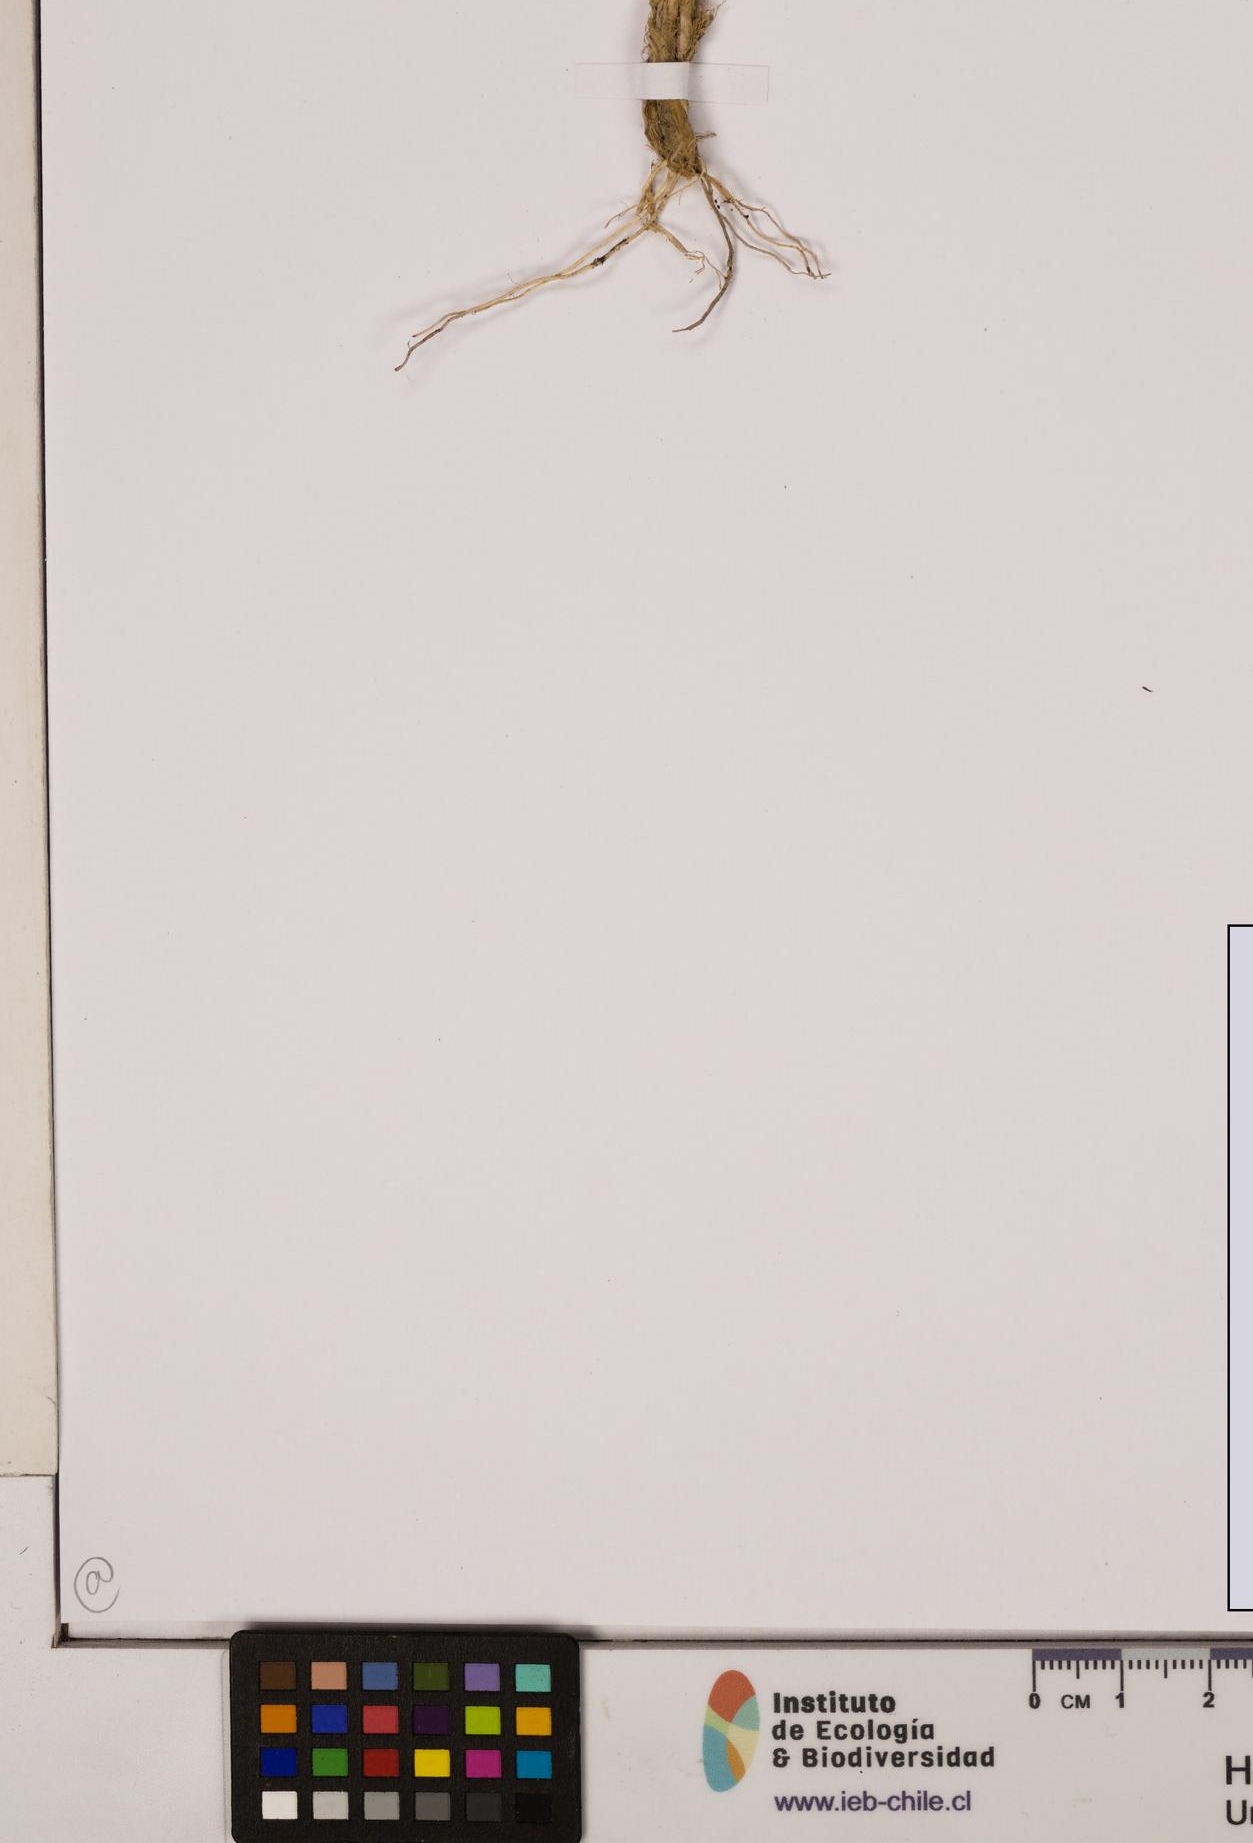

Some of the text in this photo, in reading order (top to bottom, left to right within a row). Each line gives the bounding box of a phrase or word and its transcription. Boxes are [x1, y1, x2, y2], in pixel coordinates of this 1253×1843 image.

[773, 1690, 897, 1714] Instituto
[1028, 1693, 1042, 1710] 0
[1060, 1694, 1091, 1710] CM
[1114, 1693, 1125, 1709] 1
[1202, 1692, 1215, 1709] 2
[771, 1718, 935, 1746] de Ecología
[772, 1745, 995, 1769] & Biodiversidad
[774, 1789, 971, 1813] www.ieb-chile.cl
